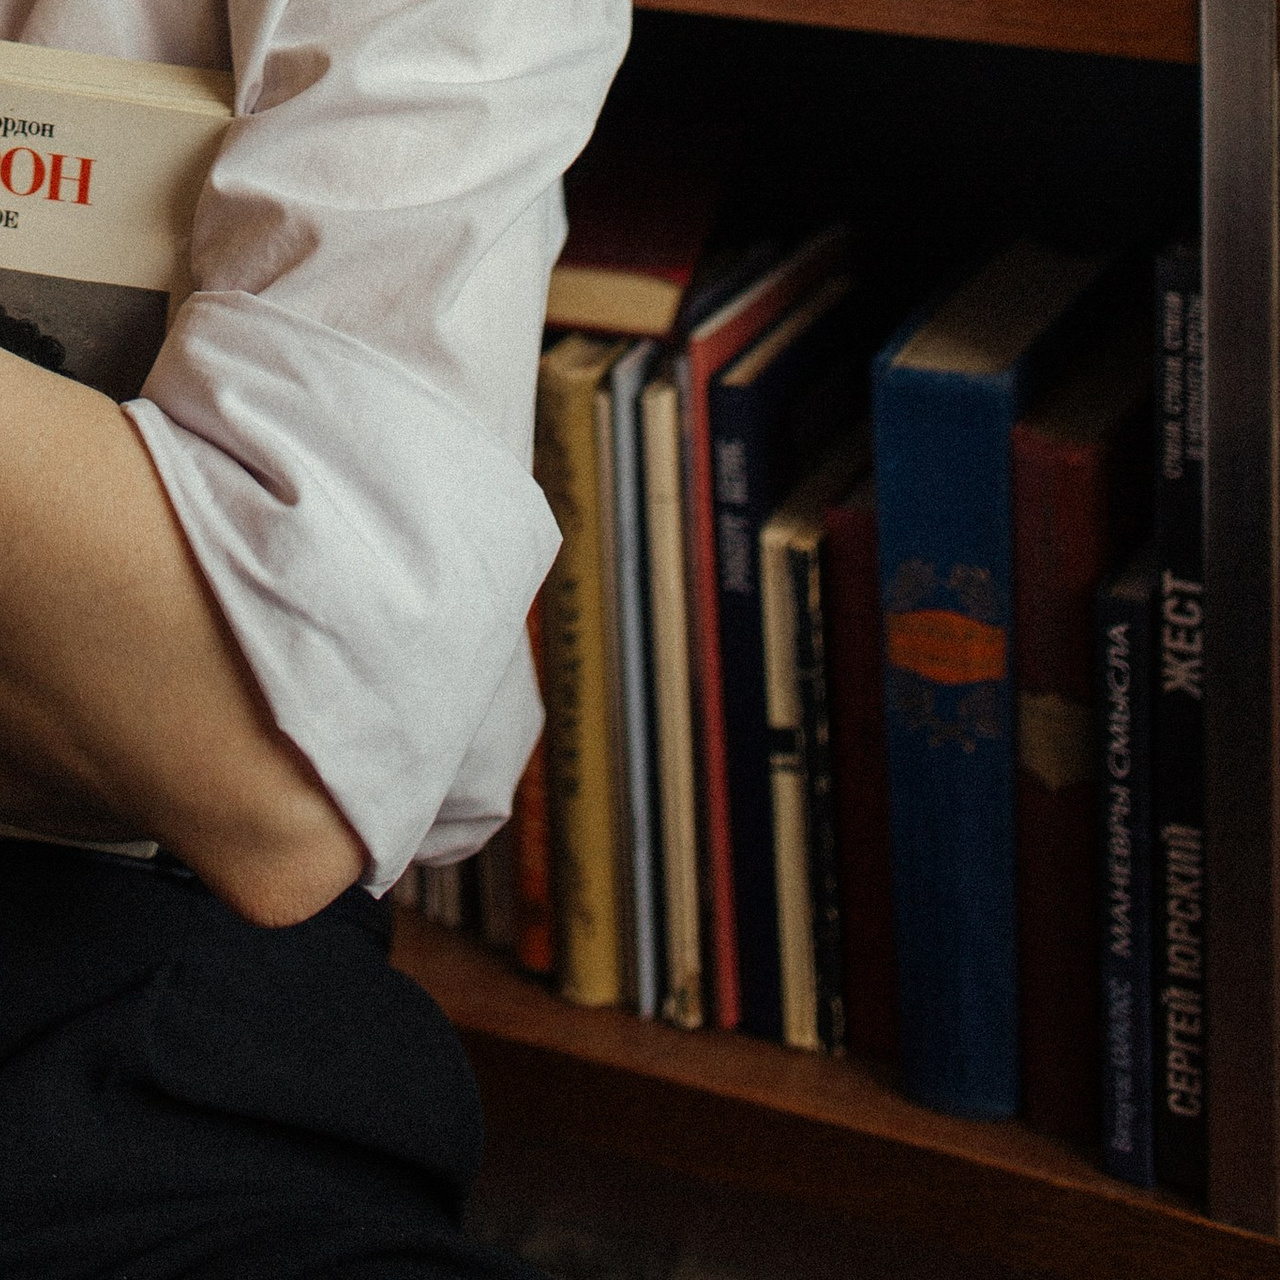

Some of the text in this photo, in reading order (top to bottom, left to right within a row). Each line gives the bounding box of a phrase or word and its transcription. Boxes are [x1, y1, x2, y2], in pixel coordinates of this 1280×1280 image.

[1107, 622, 1132, 779] СМЫСЛА
[1108, 785, 1133, 958] МАНЕВРЫ
[1161, 570, 1203, 1119] СЕРГЕЙ ЮРСКИЙ ЖЕСТ
